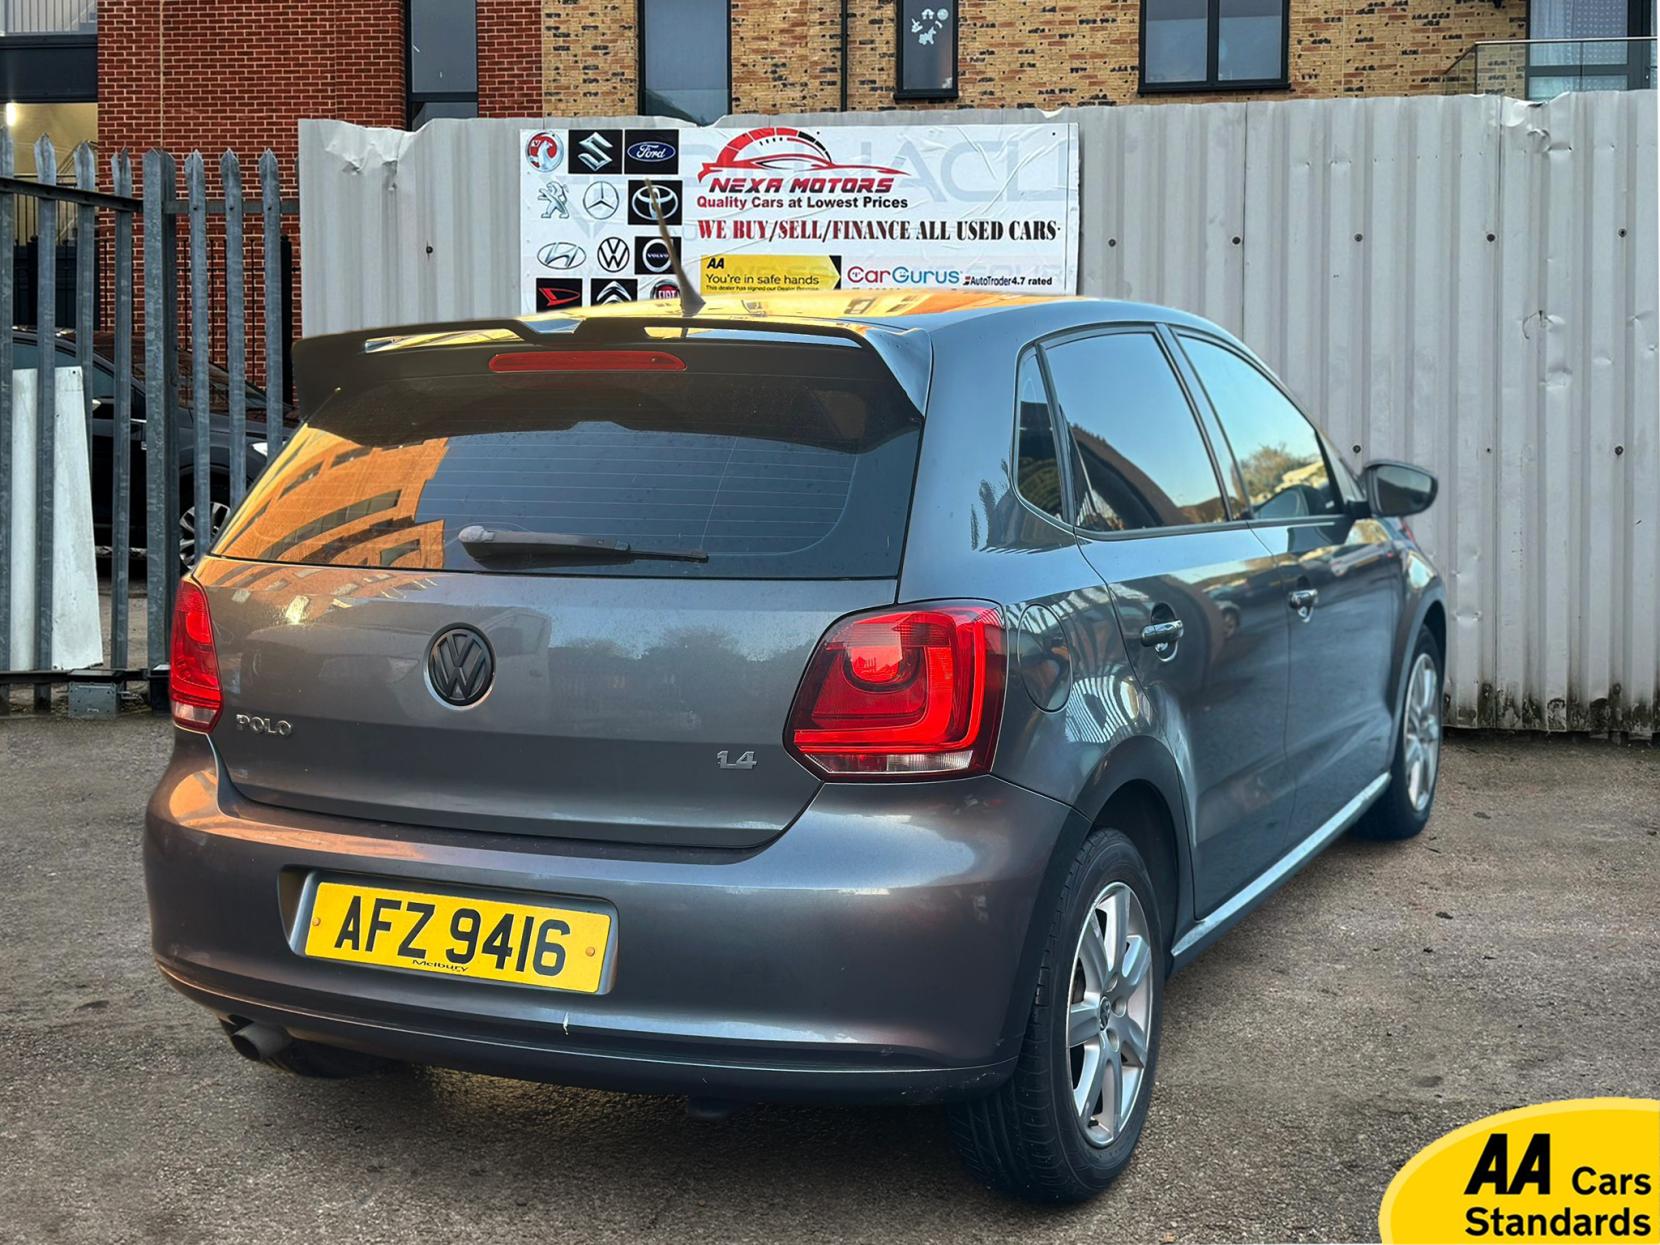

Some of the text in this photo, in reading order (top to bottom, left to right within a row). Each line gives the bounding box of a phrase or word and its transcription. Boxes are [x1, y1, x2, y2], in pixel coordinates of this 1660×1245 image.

[635, 144, 666, 159] Ford
[709, 177, 895, 194] NEXA MOTORS
[697, 195, 909, 211] Quality Cars at Lowest Prices
[697, 220, 727, 240] WE
[916, 221, 951, 241] ALL
[957, 220, 1004, 241] USED
[1009, 220, 1057, 241] CARS
[706, 257, 725, 270] AA
[705, 274, 820, 285] You're in safe hands
[847, 265, 960, 285] CarGurus
[1028, 276, 1053, 286] rated
[235, 713, 294, 737] POLO
[334, 895, 572, 978] AFZ 9416
